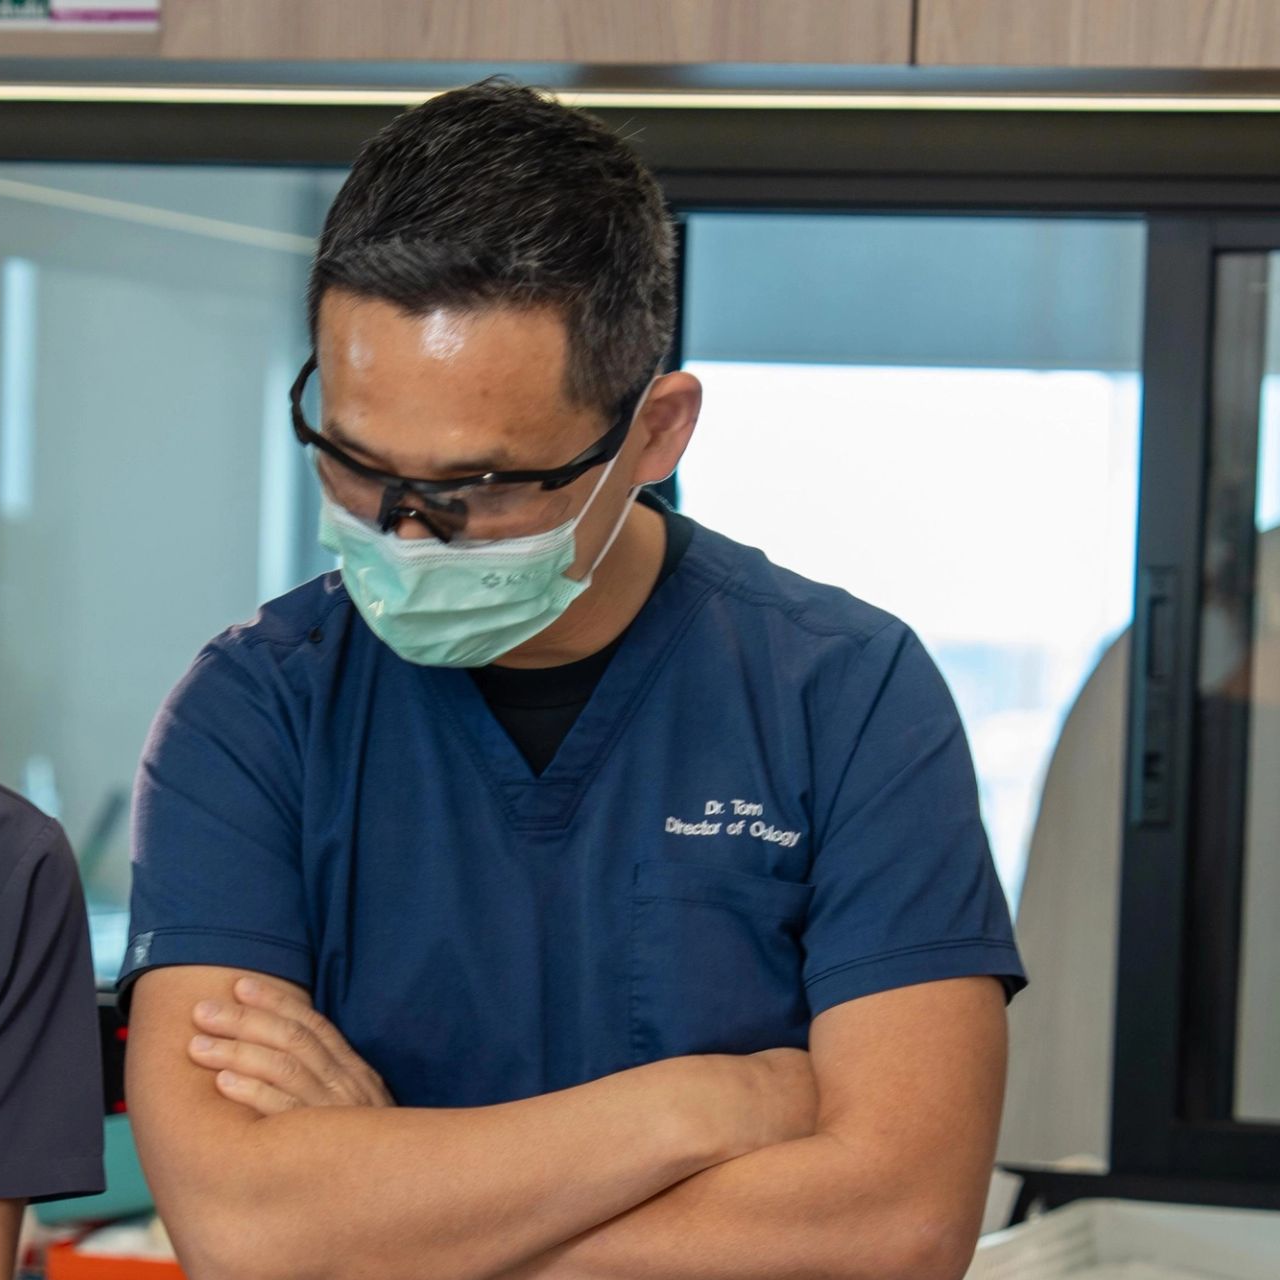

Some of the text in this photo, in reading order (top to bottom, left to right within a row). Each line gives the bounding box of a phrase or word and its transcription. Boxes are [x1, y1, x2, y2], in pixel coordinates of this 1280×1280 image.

[730, 799, 764, 816] Tom
[664, 816, 723, 836] Director
[726, 820, 746, 836] of
